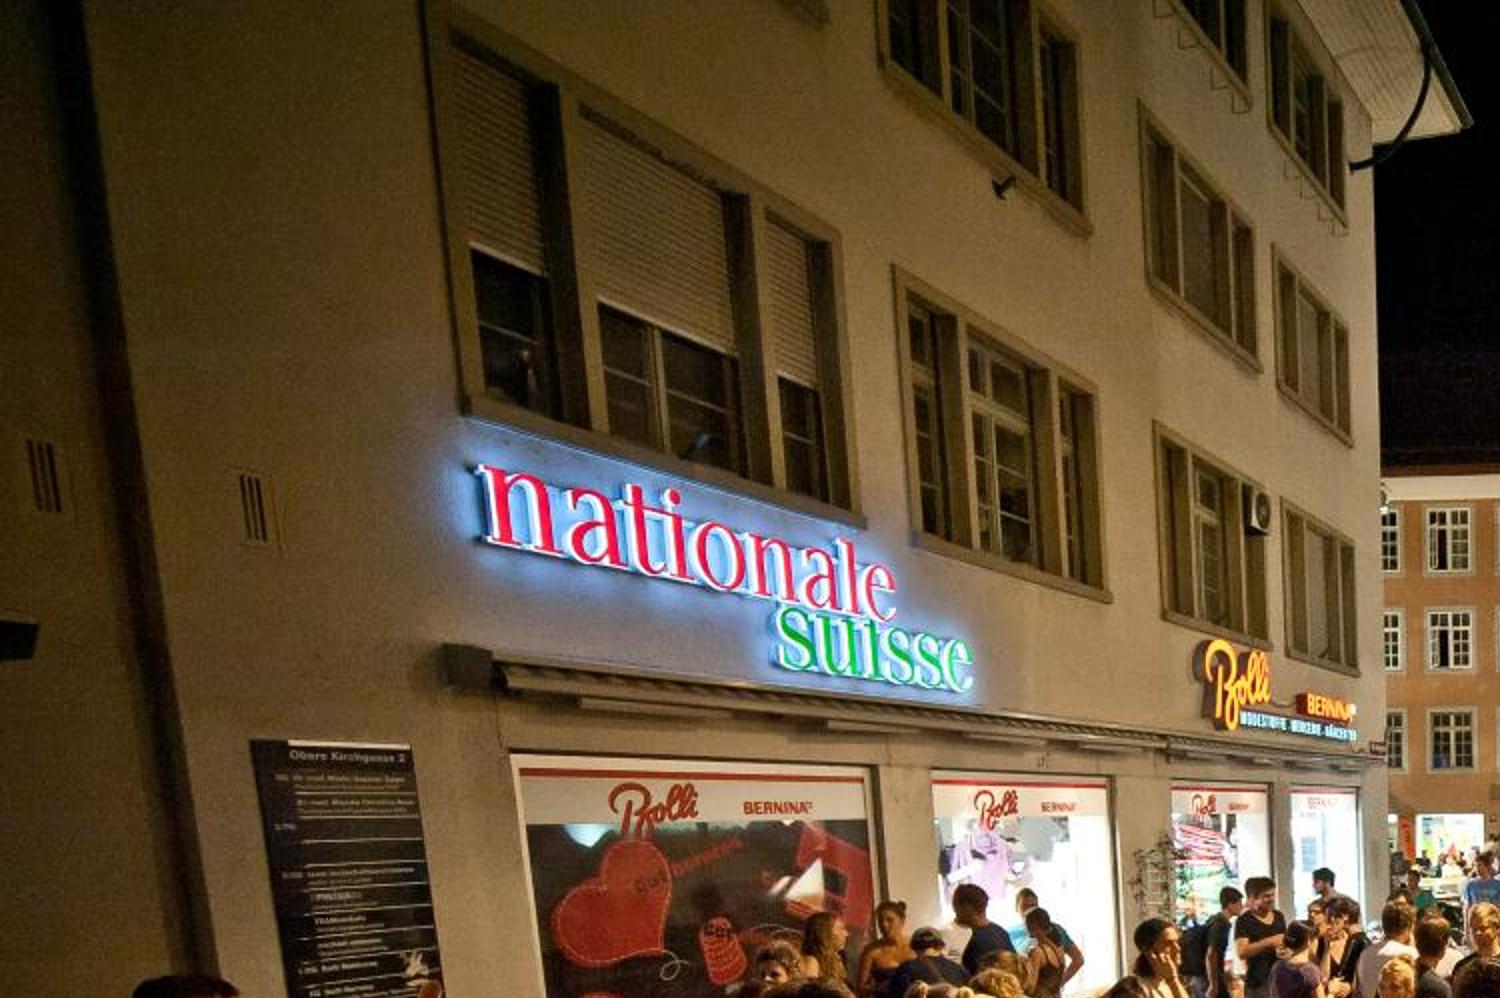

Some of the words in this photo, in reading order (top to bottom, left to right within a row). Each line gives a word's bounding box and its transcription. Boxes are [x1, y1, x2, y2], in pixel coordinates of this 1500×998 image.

[477, 463, 897, 622] nationale
[773, 605, 975, 693] suisse
[1204, 639, 1272, 731] Bolli
[608, 782, 699, 836] Bolli
[743, 800, 810, 815] BERNINA
